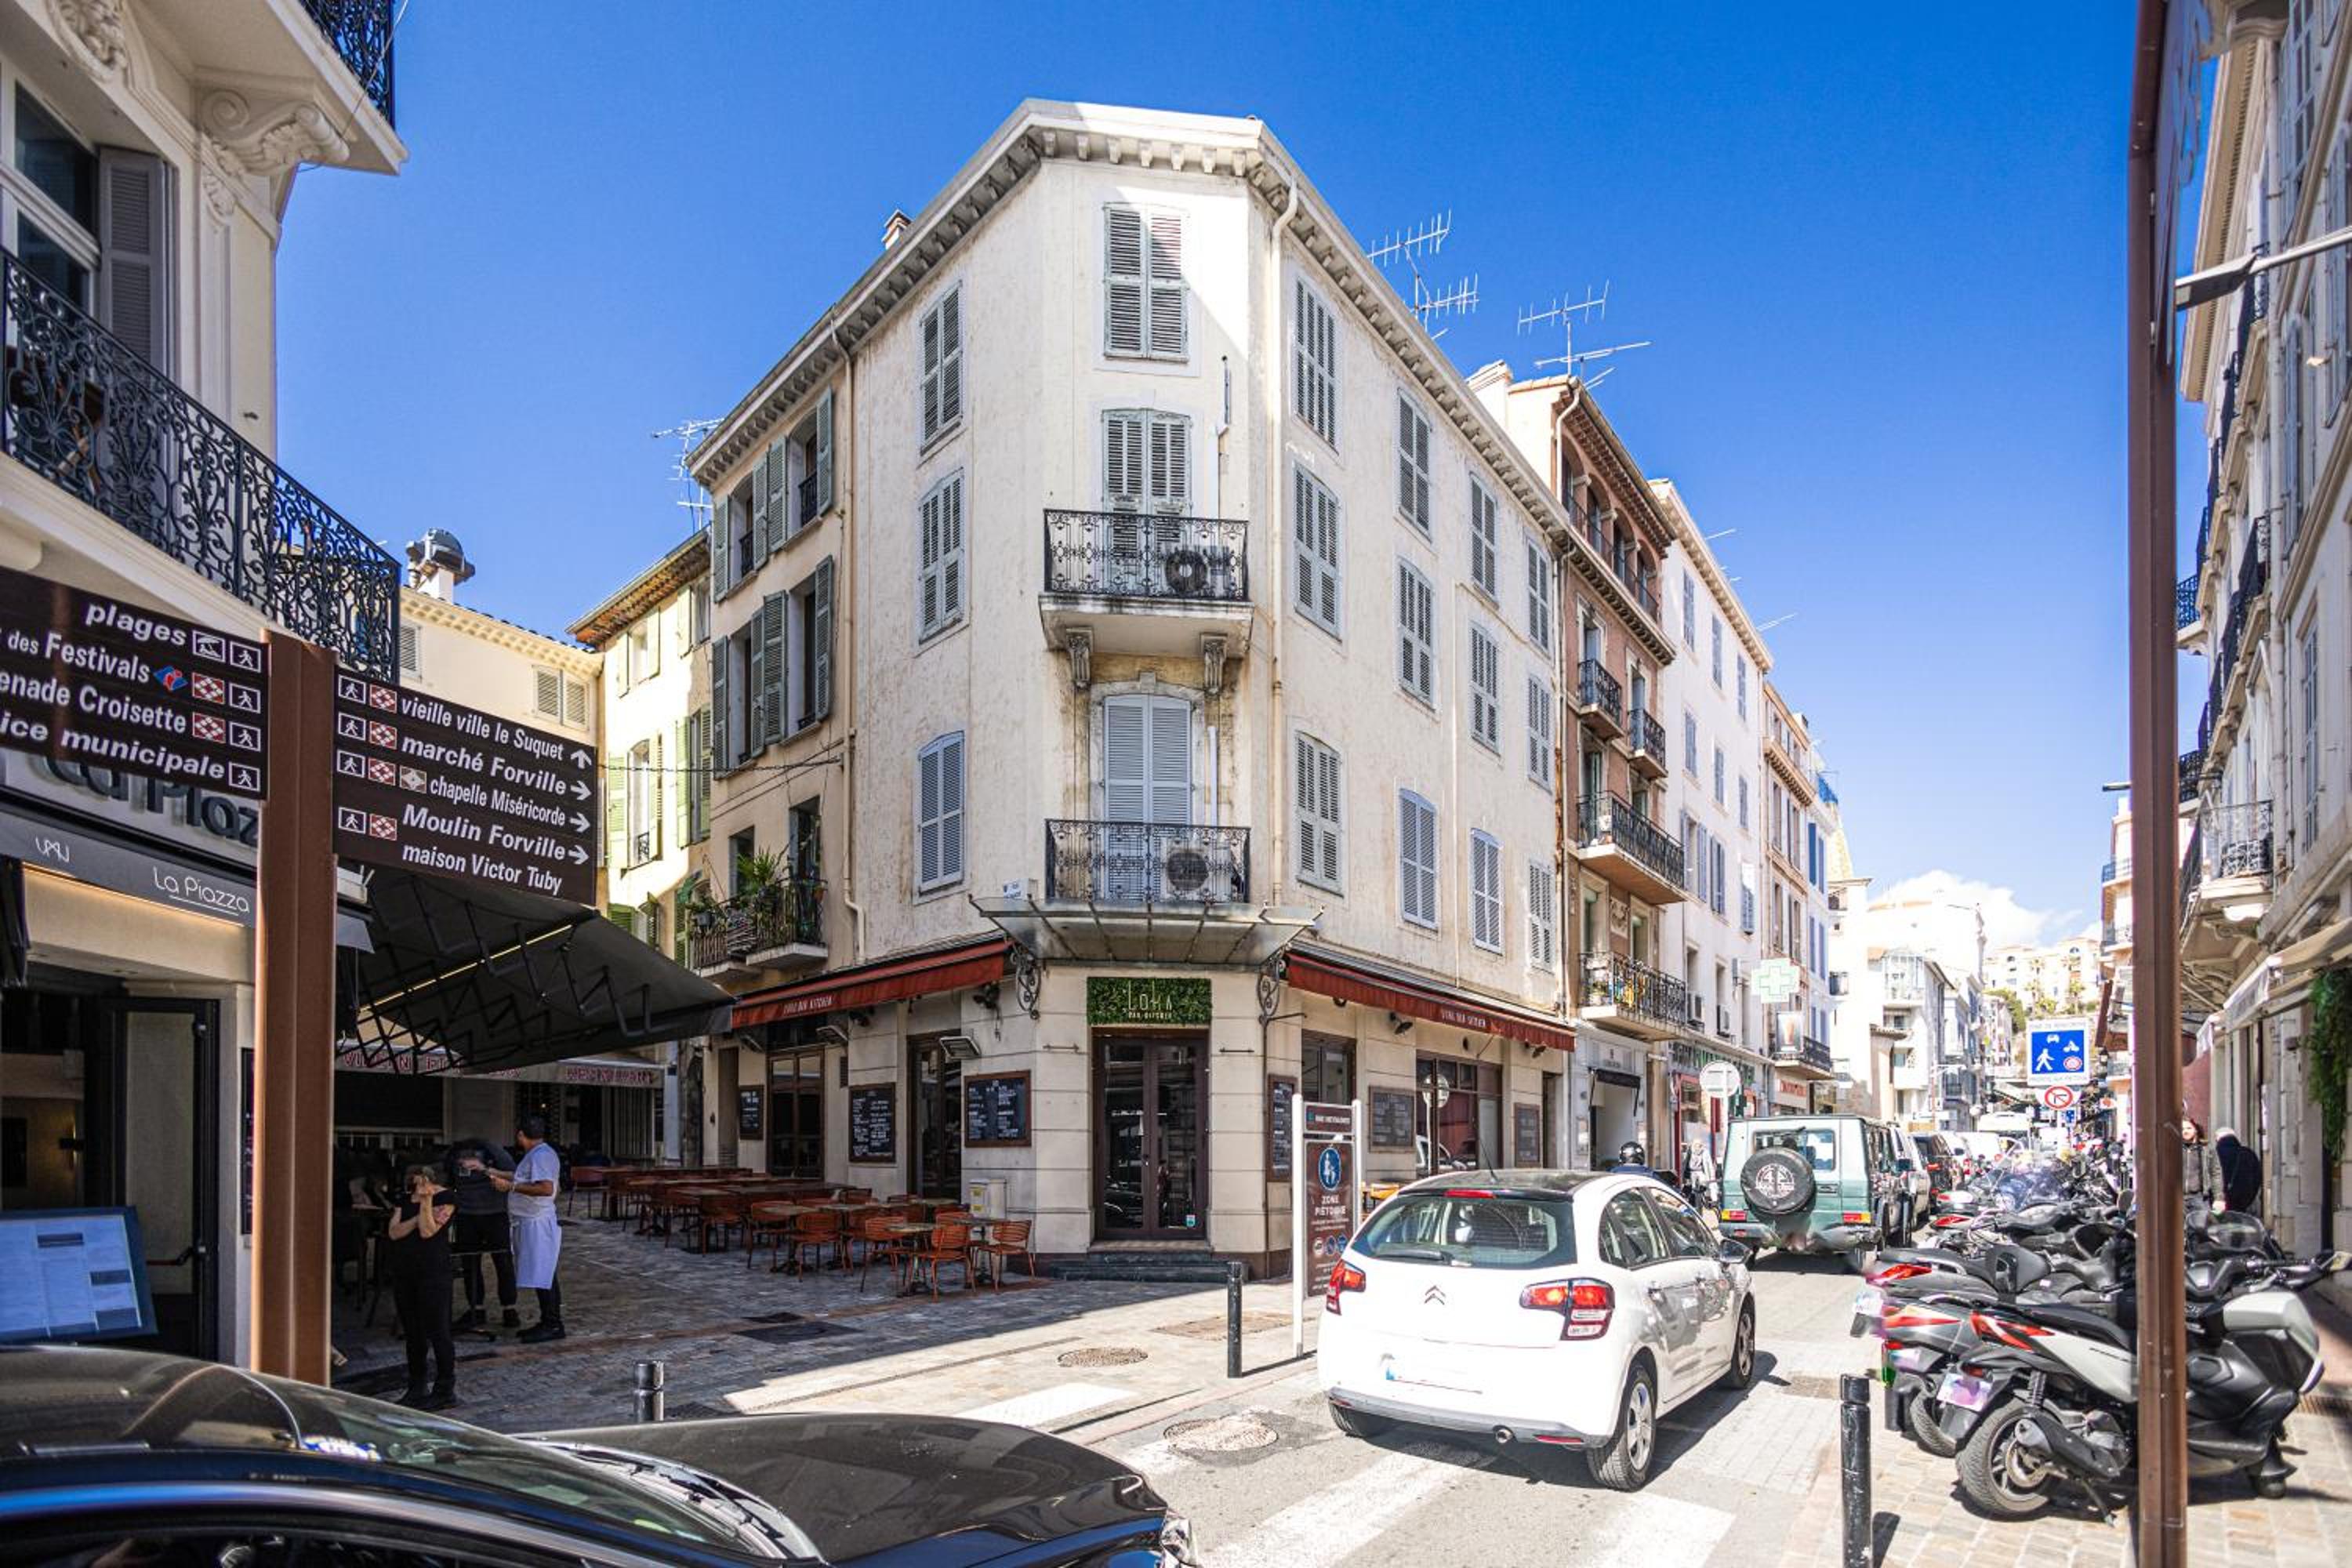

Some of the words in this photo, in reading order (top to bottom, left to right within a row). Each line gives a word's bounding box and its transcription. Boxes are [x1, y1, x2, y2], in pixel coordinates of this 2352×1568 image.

[85, 603, 187, 646] plages
[8, 631, 39, 655] des
[45, 633, 151, 684] Festivals
[79, 685, 187, 735] Croisette
[401, 697, 452, 727] vieille
[456, 712, 490, 739] ville
[495, 724, 509, 744] le
[514, 729, 564, 761] Suquet
[60, 729, 226, 779] municipale
[401, 735, 484, 772] marché
[490, 757, 567, 795] Forville
[430, 776, 487, 808] chapelle
[491, 789, 566, 827] Miséricorde
[402, 804, 481, 841] Moulin
[488, 826, 566, 862] Forville
[153, 866, 180, 894] La
[184, 876, 250, 913] Piazza
[401, 843, 466, 873] maison
[471, 855, 522, 884] Victor
[527, 866, 563, 896] Tuby
